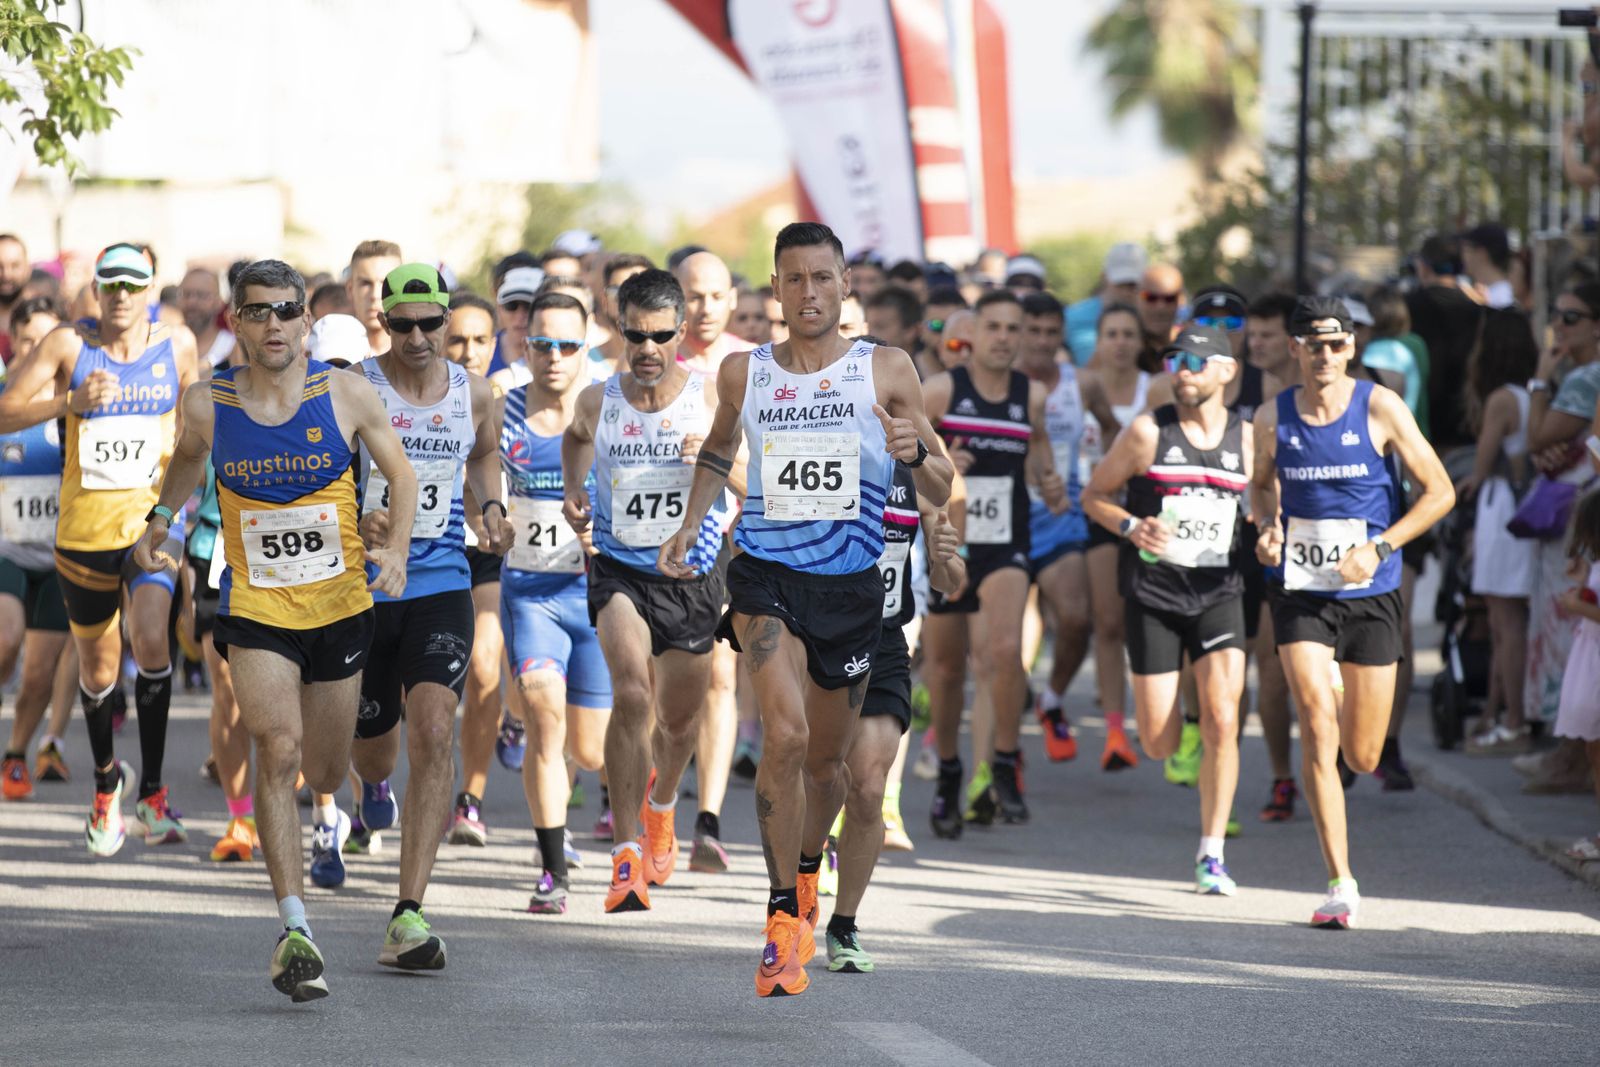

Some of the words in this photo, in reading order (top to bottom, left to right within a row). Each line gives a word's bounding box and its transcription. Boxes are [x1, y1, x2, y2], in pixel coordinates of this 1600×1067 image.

[758, 403, 855, 424] MARACENA
[802, 421, 843, 429] ATLETISMO
[95, 440, 145, 463] 597
[402, 436, 461, 454] RACENA
[609, 442, 684, 457] MARACEN
[224, 452, 332, 481] agustinos
[778, 460, 843, 491] 465
[1283, 463, 1369, 481] TROTASIERRA
[626, 492, 683, 520] 475
[528, 522, 557, 547] 21
[1177, 520, 1221, 541] 585
[261, 531, 324, 559] 598
[1293, 543, 1356, 567] 304
